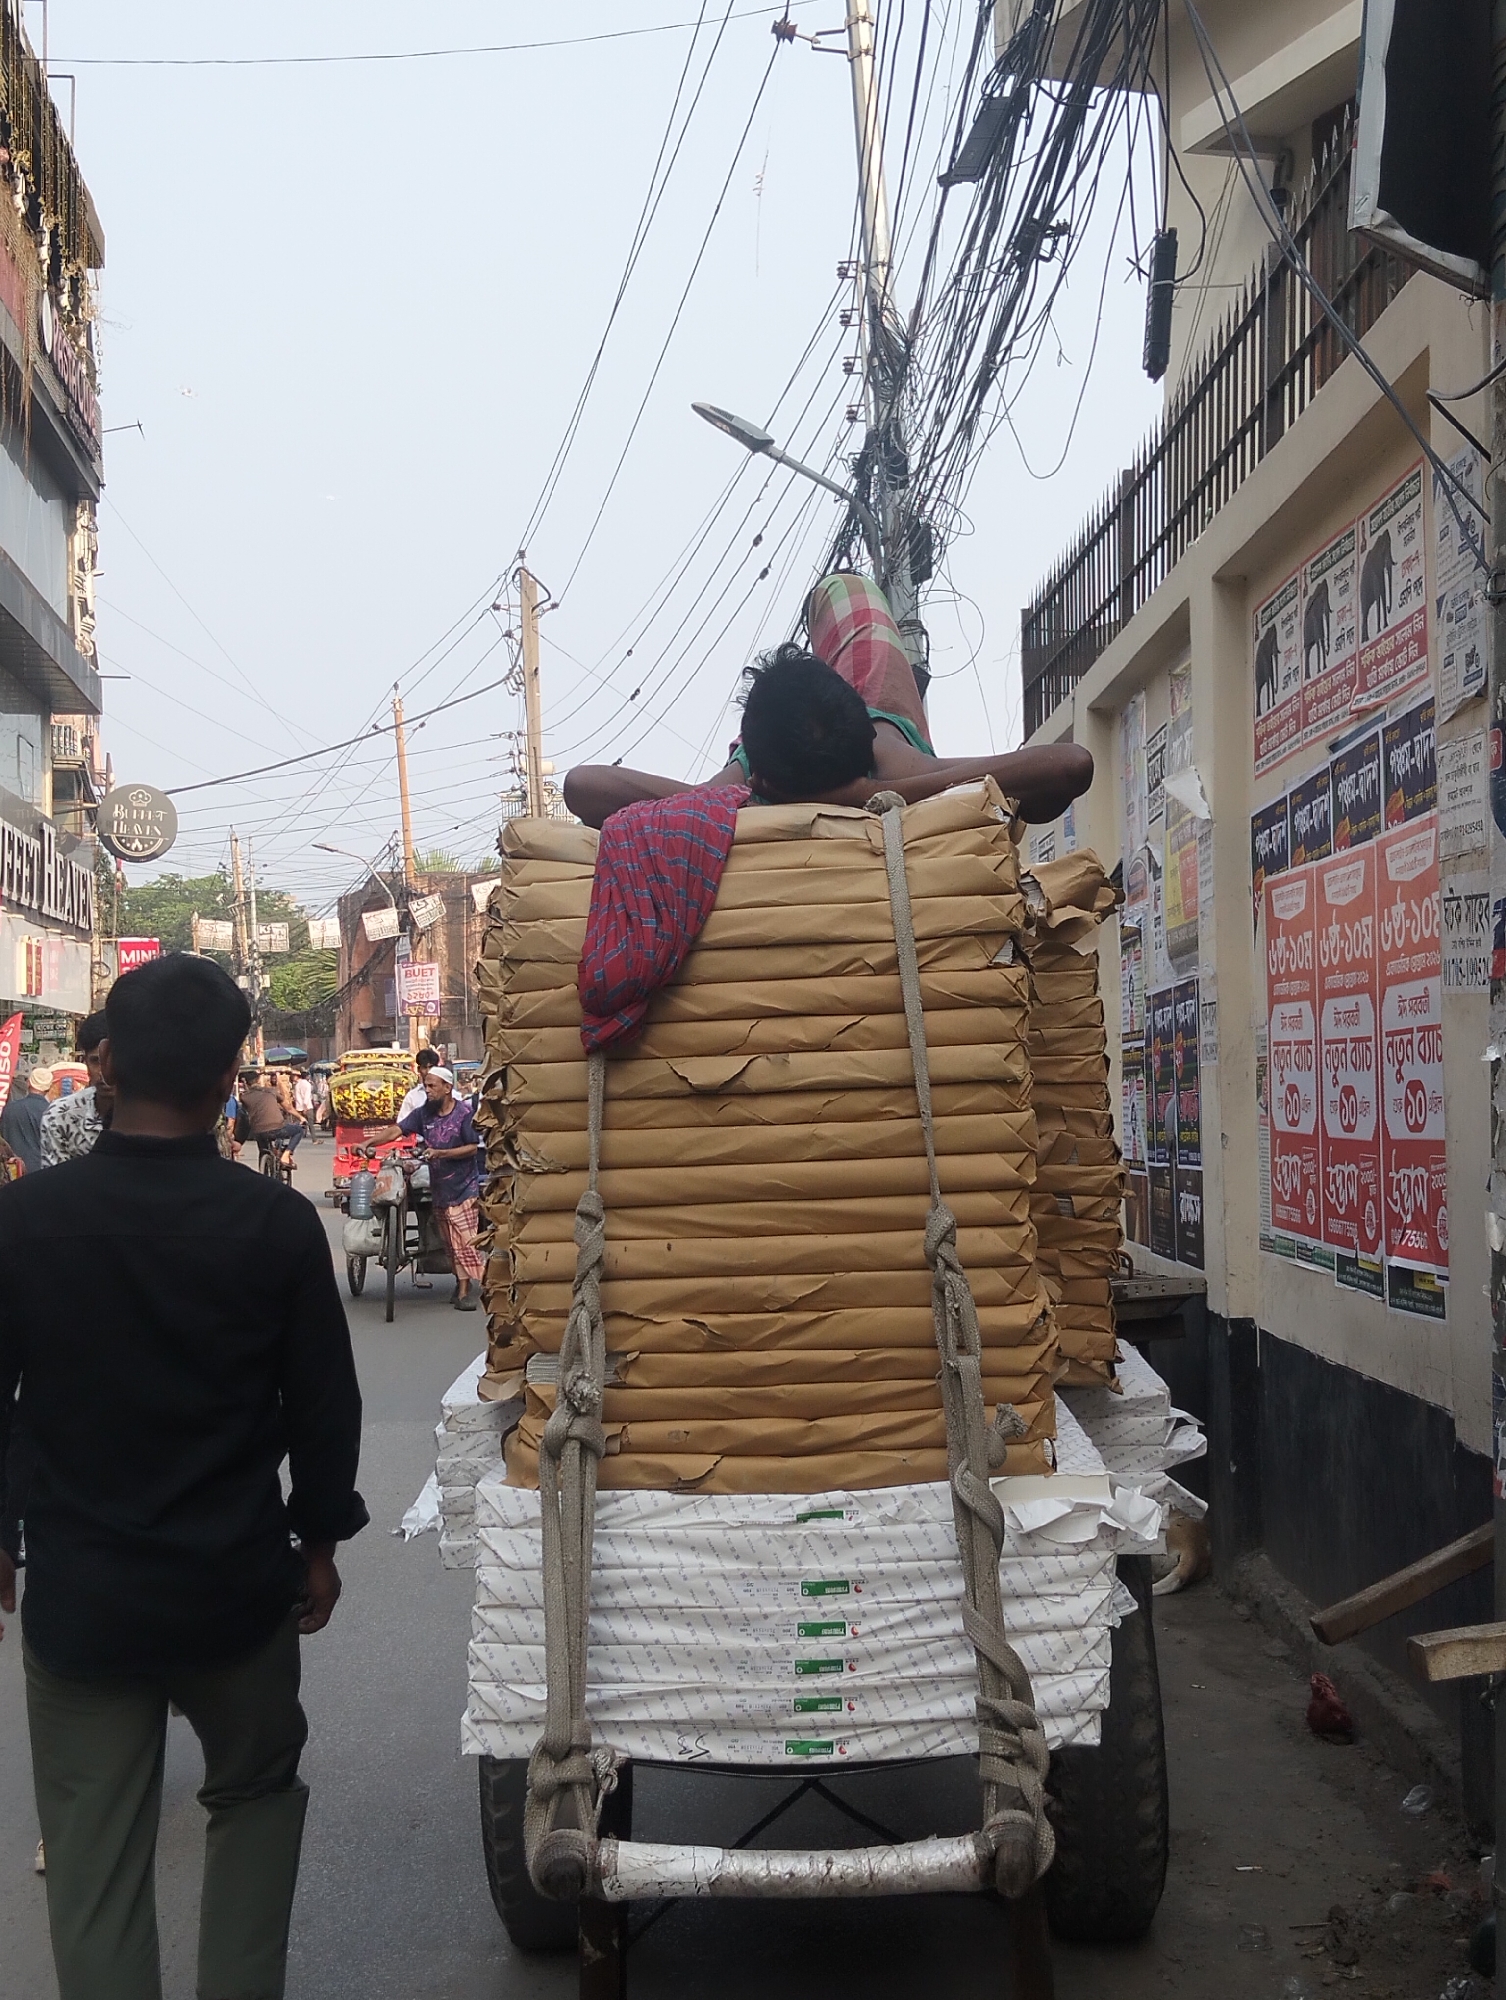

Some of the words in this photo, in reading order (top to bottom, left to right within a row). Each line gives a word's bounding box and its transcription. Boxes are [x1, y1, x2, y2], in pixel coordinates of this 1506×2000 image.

[0, 816, 41, 911] FFET
[42, 822, 96, 931] HEAVEN
[405, 968, 435, 978] BUET
[1273, 1040, 1292, 1086] নতুন
[1293, 1039, 1313, 1072] ব্যাচ
[1324, 1037, 1348, 1088] নতুন
[1349, 1036, 1372, 1072] ব্যাচ
[1385, 1027, 1414, 1084] নতুন
[1416, 1023, 1443, 1064] ব্যাচ
[1286, 1088, 1300, 1122] ১০
[1341, 1092, 1356, 1126] ১০
[1406, 1088, 1425, 1126] ১০
